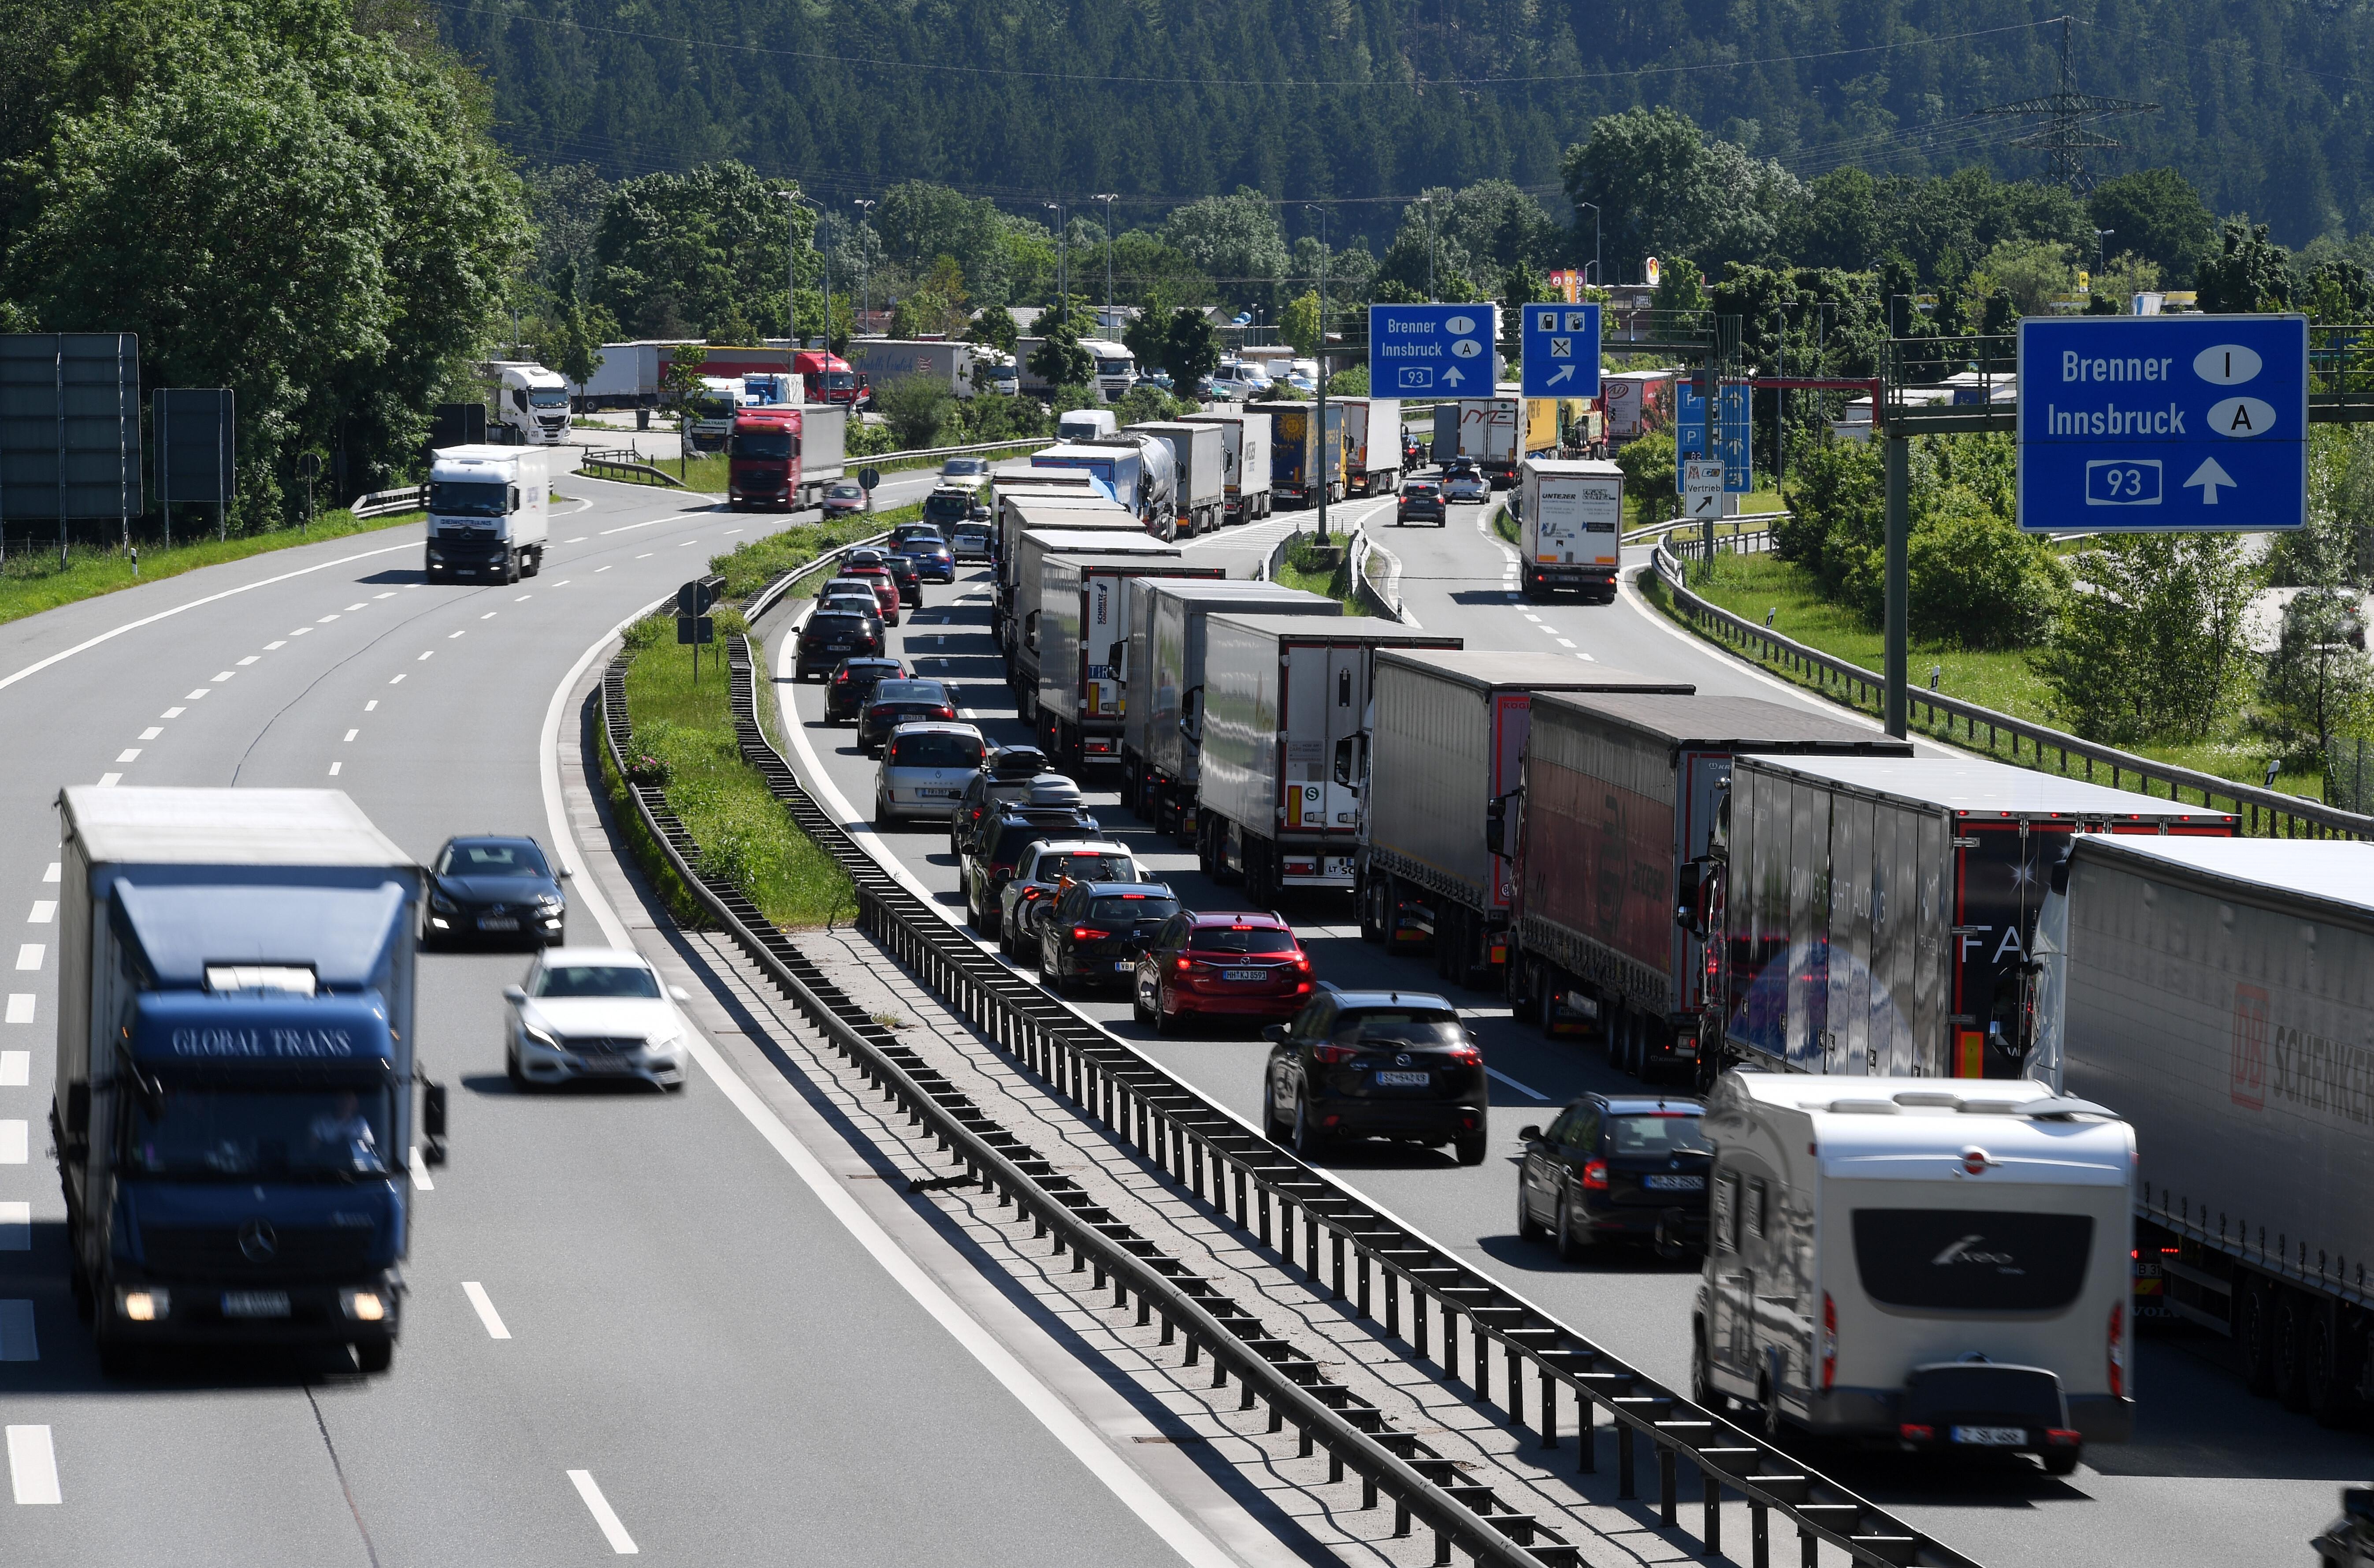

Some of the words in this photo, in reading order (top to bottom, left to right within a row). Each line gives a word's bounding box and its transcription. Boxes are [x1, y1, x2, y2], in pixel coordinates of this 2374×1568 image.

[1388, 318, 1436, 333] Brenner
[1459, 320, 1462, 331] I
[1382, 342, 1442, 357] Innsbruck
[1462, 343, 1471, 355] A
[2062, 350, 2173, 383] Brenner
[2225, 352, 2230, 378] I
[1408, 372, 1423, 384] 93
[2048, 402, 2186, 435] Innsbruck
[2230, 404, 2252, 431] A
[2107, 468, 2142, 496] 93
[1089, 666, 1108, 678] TIR
[1784, 864, 1819, 904] MOVING
[1822, 875, 1851, 913] RGHT
[1852, 884, 1886, 924] ALONG
[1226, 970, 1236, 979] HH
[1240, 971, 1249, 979] KJ
[1250, 971, 1266, 980] 8591
[172, 1027, 265, 1056] GLOBAL
[270, 1027, 352, 1057] TRANS
[2235, 1003, 2264, 1089] DB
[2139, 1264, 2146, 1274] B
